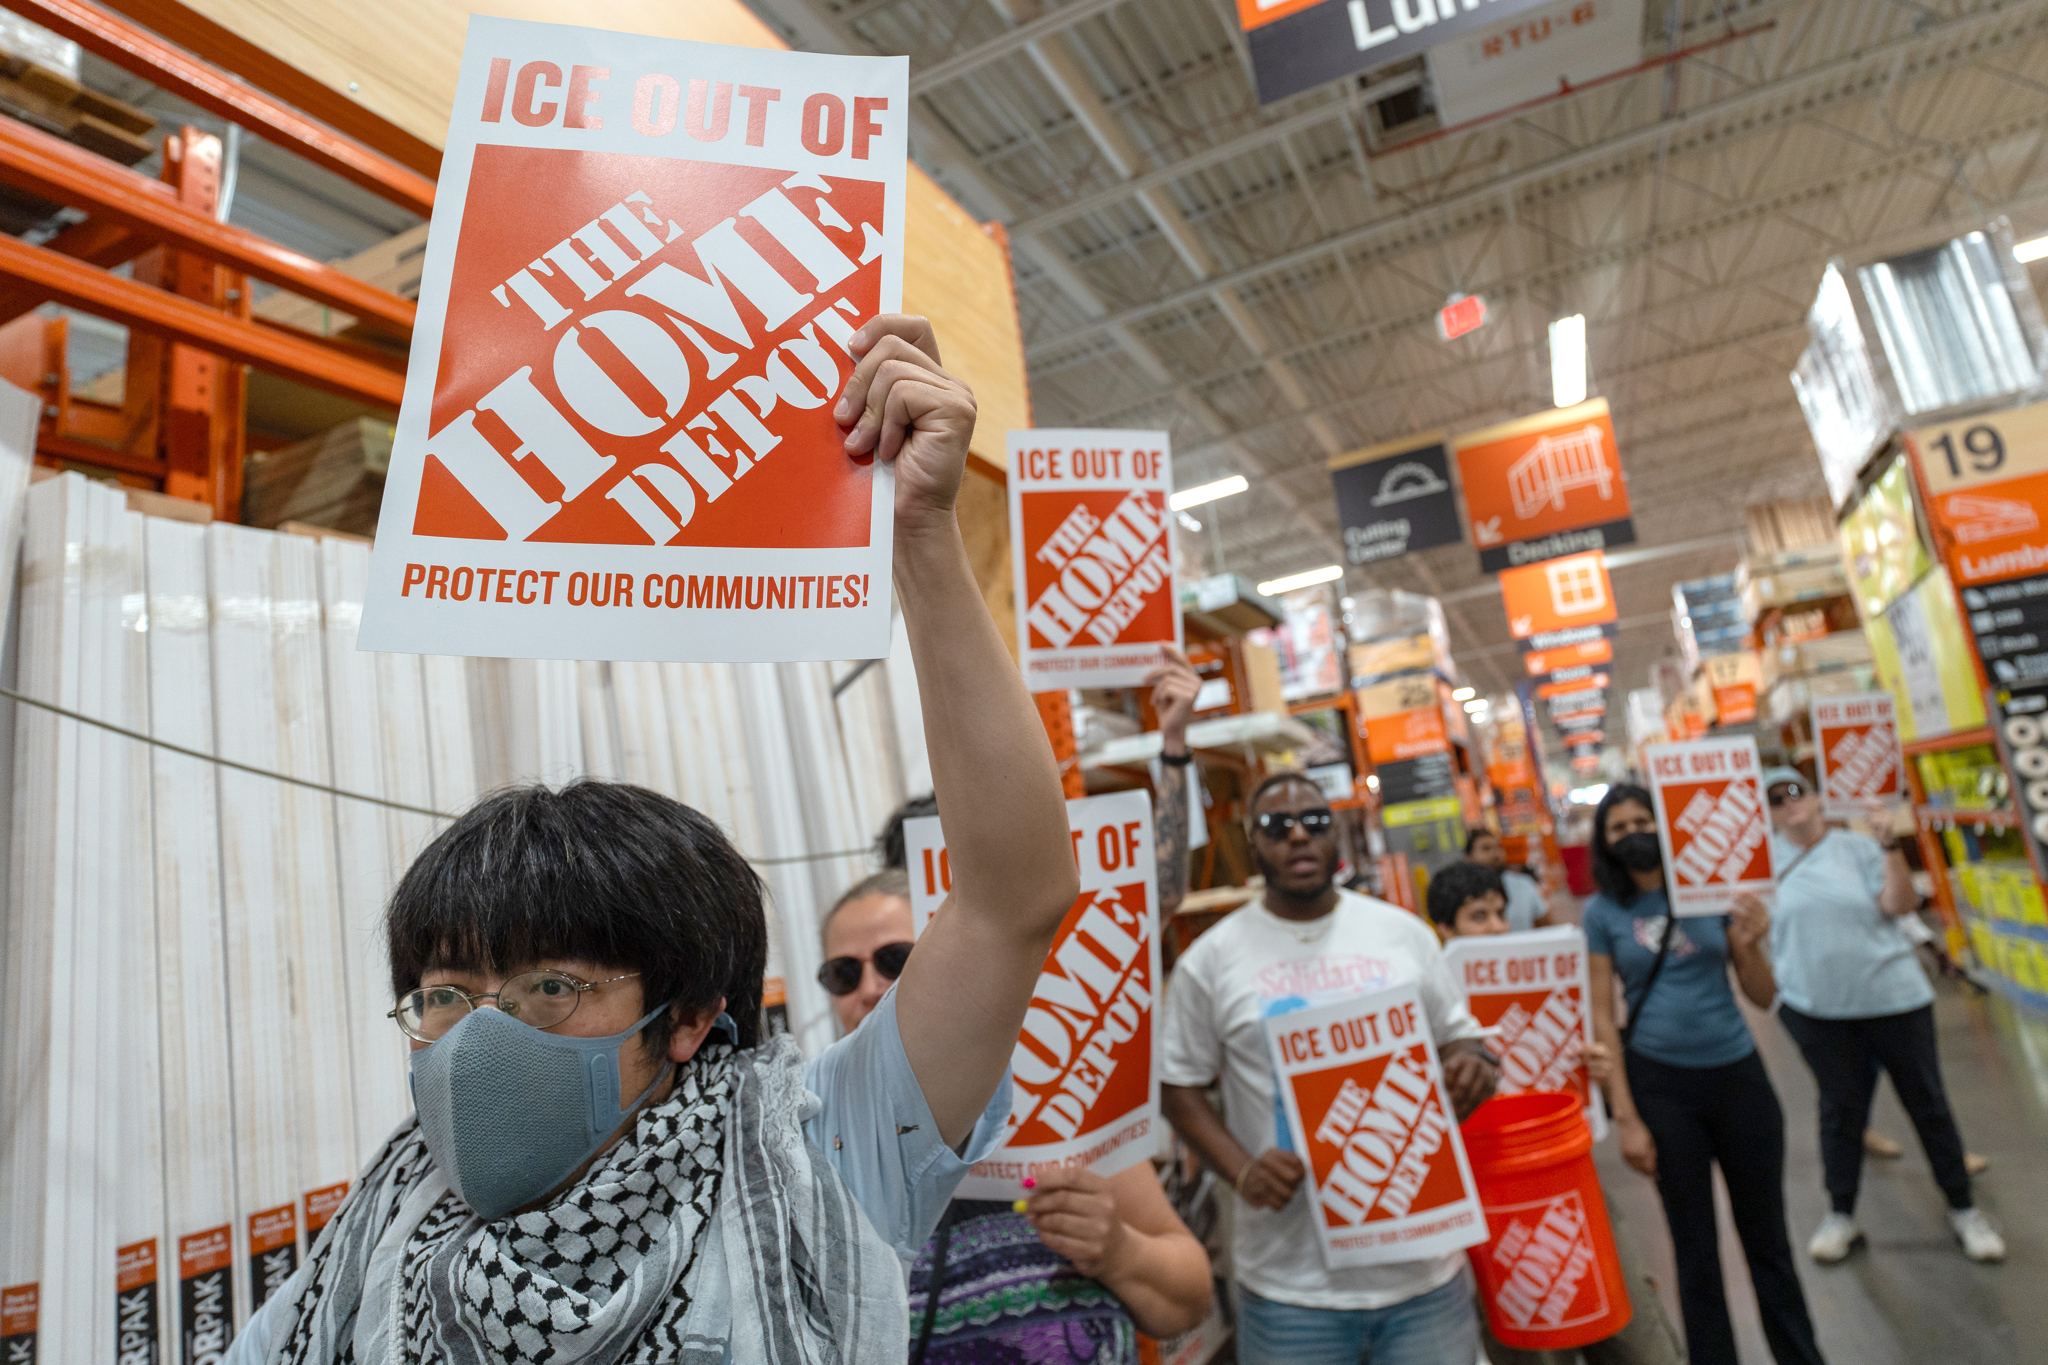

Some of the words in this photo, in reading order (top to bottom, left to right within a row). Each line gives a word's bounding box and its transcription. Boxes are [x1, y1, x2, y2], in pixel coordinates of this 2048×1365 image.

[481, 57, 611, 130] ICE
[631, 72, 781, 148] OUT
[800, 93, 888, 160] OF
[491, 190, 684, 331] THE
[426, 170, 883, 541] HOME
[605, 297, 862, 546] DEPOT
[1017, 449, 1062, 481] ICE
[1071, 449, 1123, 480] OUT
[1132, 450, 1162, 480] OF
[1929, 425, 2006, 478] 19
[401, 563, 559, 605] PROTECT
[567, 571, 634, 609] OUR
[642, 574, 869, 610] COMMUNITIES!
[1026, 488, 1168, 648] HOME
[1035, 503, 1101, 571] THE
[1085, 543, 1173, 646] DEPOT
[1654, 754, 1683, 777] ICE
[1691, 750, 1726, 776] OUT
[1097, 821, 1141, 872] OF
[1674, 777, 1758, 885] HOME
[1464, 960, 1498, 986] ICE
[1507, 956, 1547, 983] OUT
[1554, 953, 1578, 979] OF
[1036, 968, 1152, 1141] DEPOT
[1278, 1028, 1324, 1065] ICE
[1330, 1012, 1379, 1055] OUT
[1387, 1002, 1416, 1038] OF
[1498, 986, 1583, 1095] OME
[1315, 1078, 1371, 1150] THE
[1318, 1045, 1441, 1226] HOME
[1376, 1099, 1450, 1217] DEPOT
[1496, 1198, 1585, 1328] HOME
